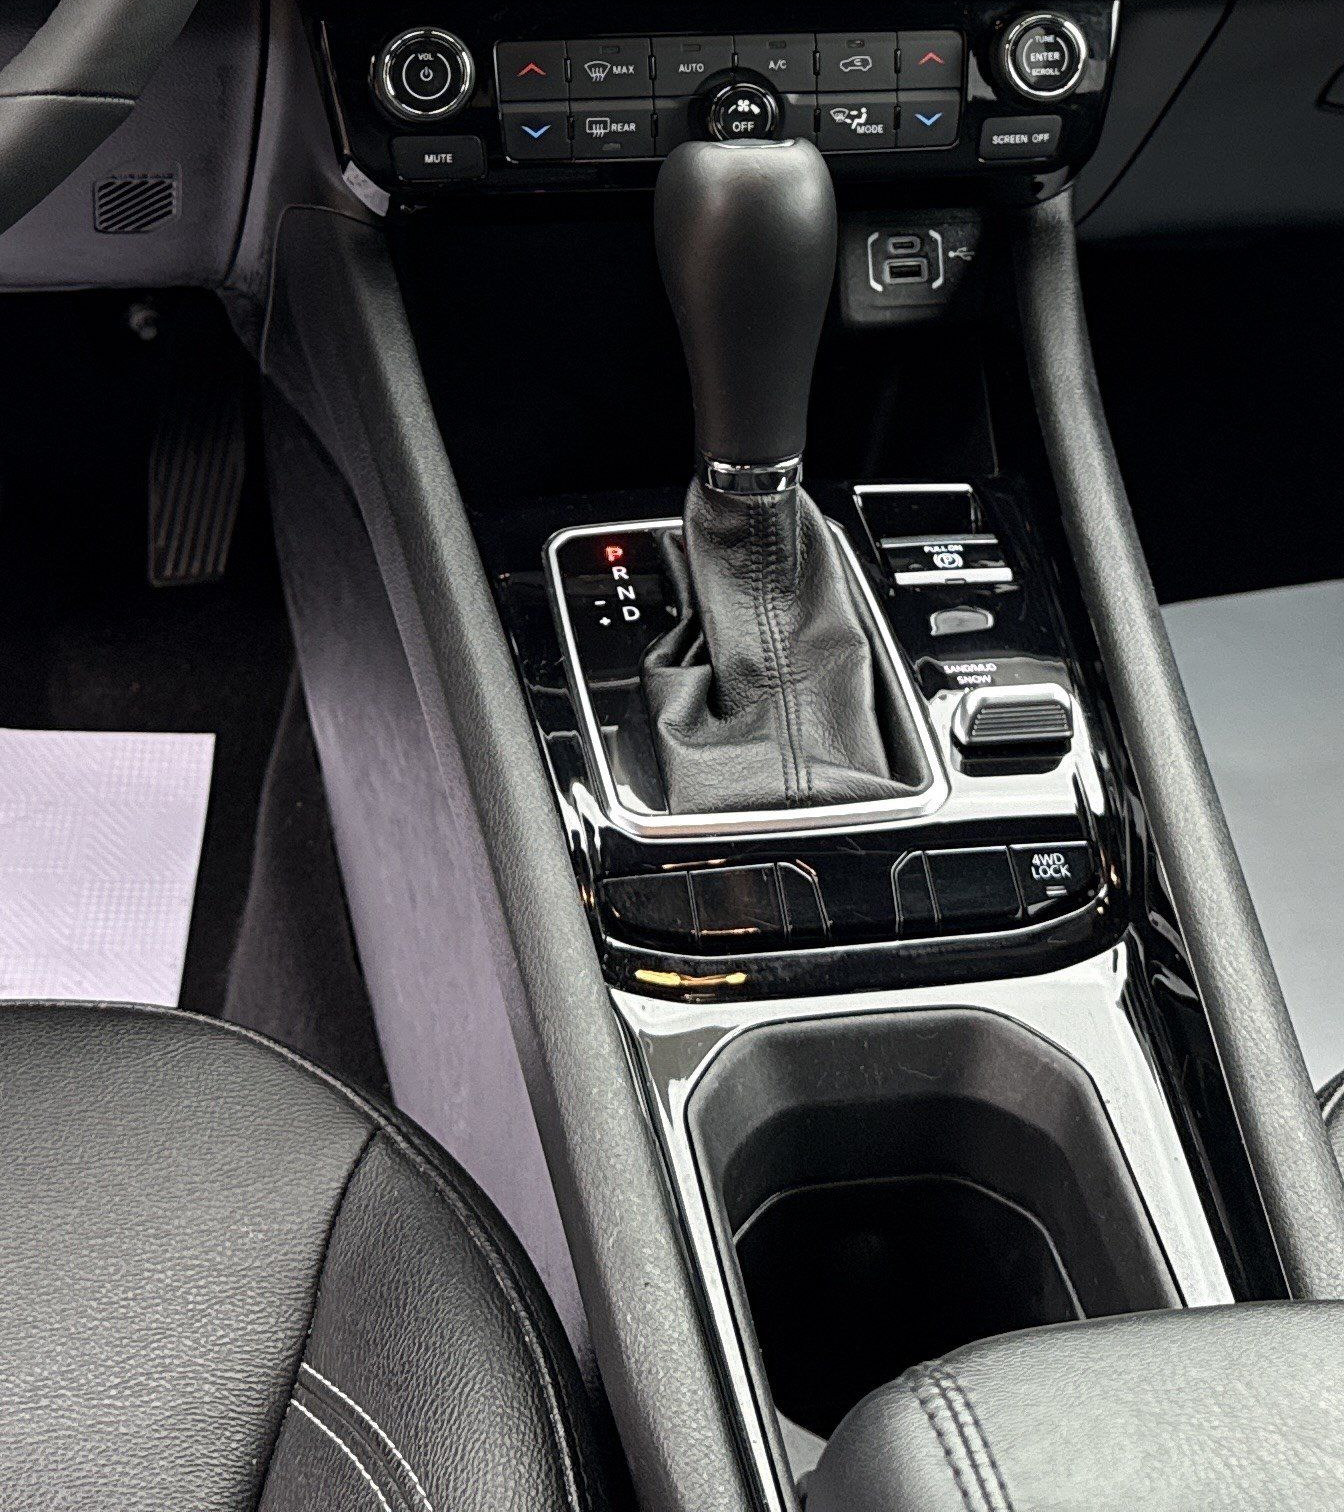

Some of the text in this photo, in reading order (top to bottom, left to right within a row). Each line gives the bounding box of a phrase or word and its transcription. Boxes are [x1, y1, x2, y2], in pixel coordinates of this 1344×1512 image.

[1035, 35, 1055, 43] TUNE
[417, 52, 435, 61] VOL
[1030, 52, 1060, 62] ENTER
[612, 65, 635, 75] MAX
[678, 63, 705, 73] AUTO
[768, 59, 788, 70] A/C
[1031, 68, 1060, 76] SCROLL
[610, 122, 636, 133] REAR
[732, 121, 755, 133] OFF
[856, 124, 884, 134] MODE
[992, 133, 1050, 145] SCREEN OFF
[424, 154, 453, 164] MUTE
[605, 546, 624, 562] P
[611, 566, 629, 580] R
[616, 585, 636, 600] N
[622, 606, 640, 621] D
[956, 675, 991, 685] SNOW
[1031, 853, 1065, 866] 4WD
[1031, 864, 1072, 880] LOCK
